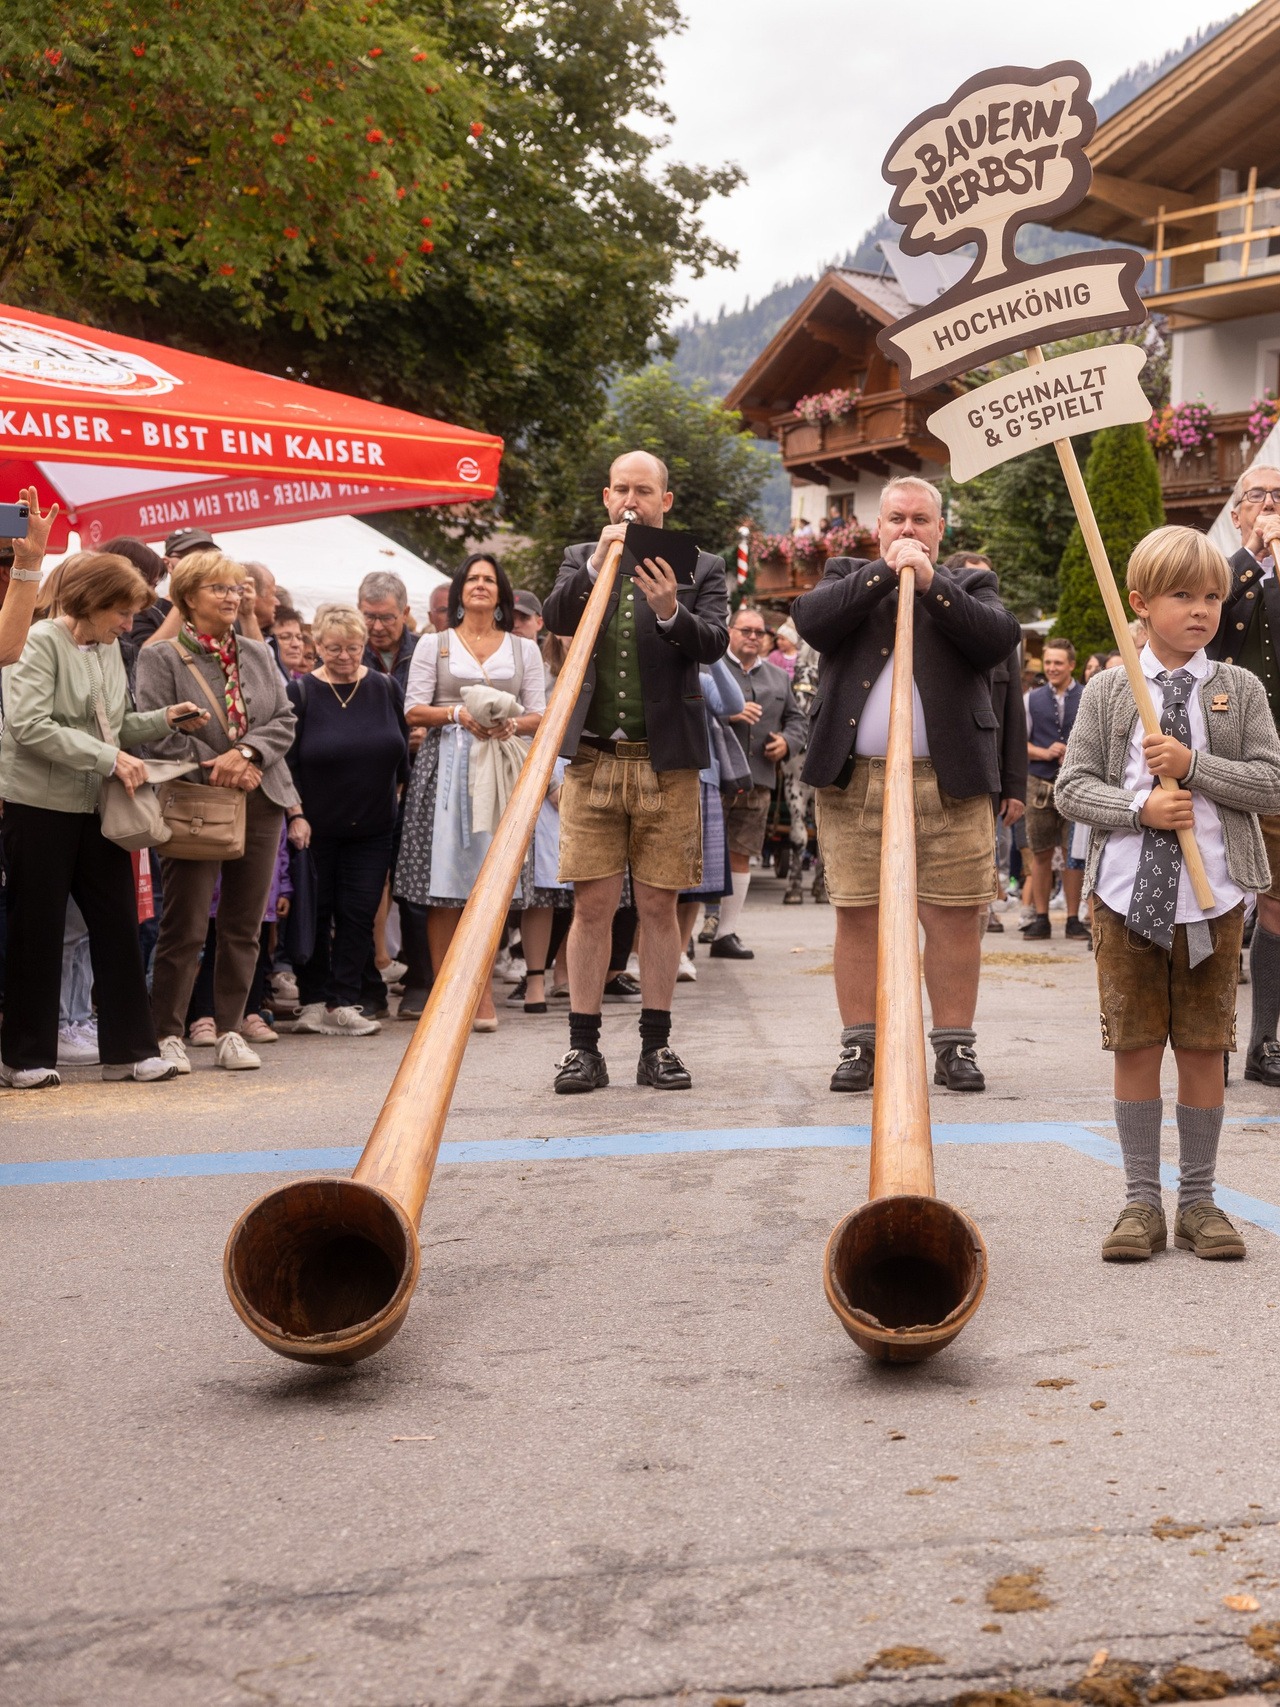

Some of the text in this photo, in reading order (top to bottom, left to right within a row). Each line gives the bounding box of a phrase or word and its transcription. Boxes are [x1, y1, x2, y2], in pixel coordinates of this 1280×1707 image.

[915, 100, 1066, 185] BAUERN
[926, 144, 1059, 225] HERBST
[932, 282, 1091, 351] HOCHKÖNIG
[967, 365, 1107, 429] G'SCHNALZT
[984, 390, 1104, 447] & G'SPIELT
[0, 410, 114, 443] KAISER
[142, 421, 208, 450] BIST
[221, 429, 272, 457] EIN
[284, 434, 385, 466] KAISER
